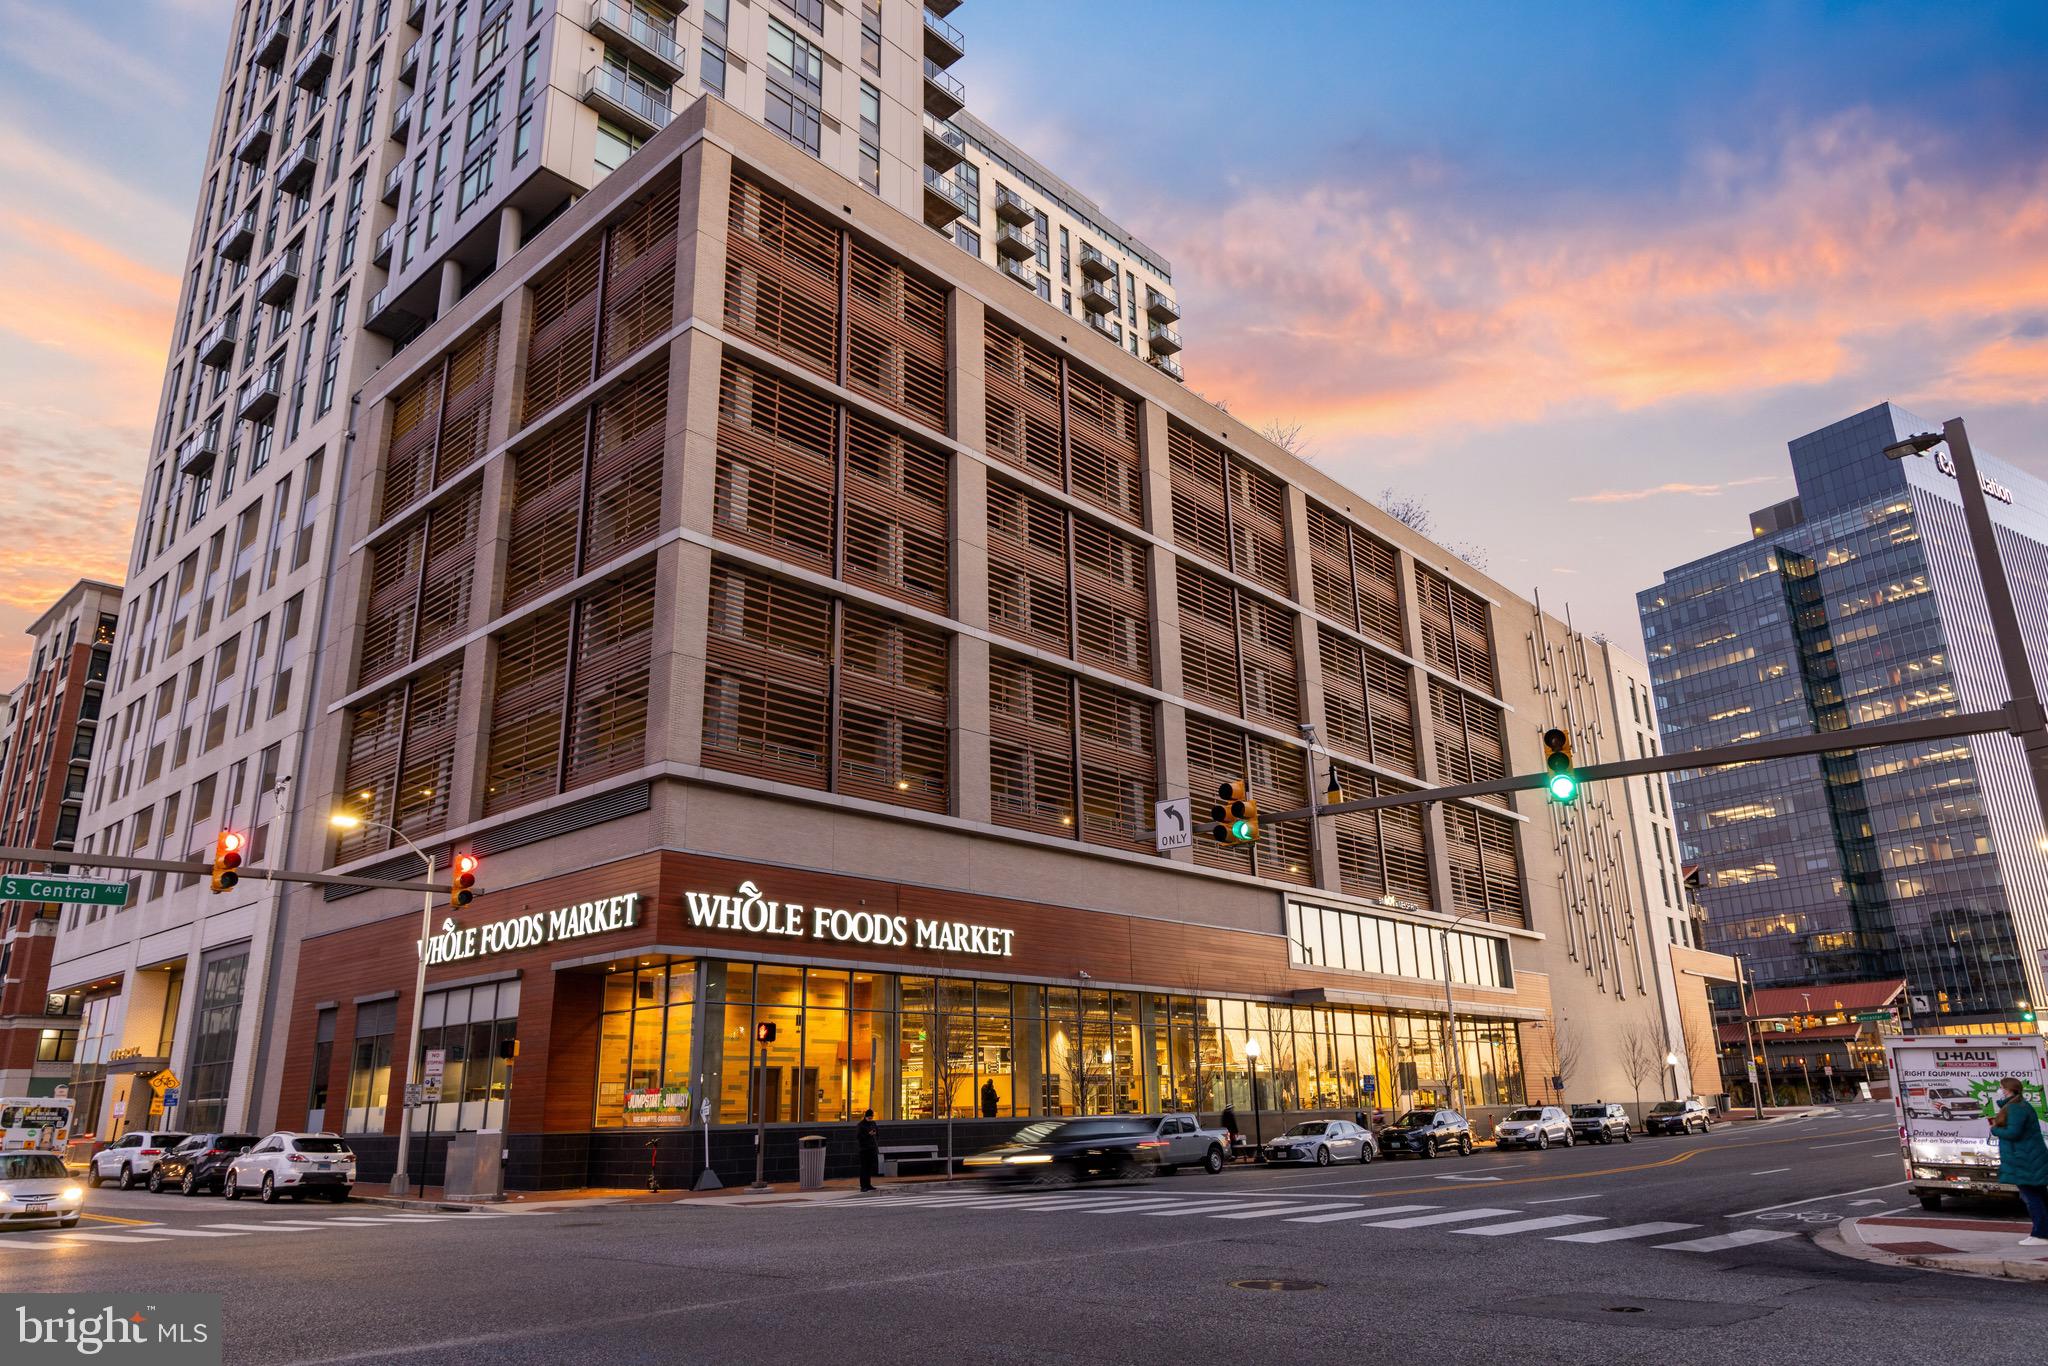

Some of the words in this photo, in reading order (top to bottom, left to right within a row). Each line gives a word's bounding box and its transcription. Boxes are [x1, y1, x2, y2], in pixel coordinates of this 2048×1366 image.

[1162, 833, 1187, 846] ONLY
[5, 881, 20, 895] S.
[30, 882, 97, 899] Central
[105, 886, 124, 894] AVE
[479, 915, 544, 955] FOODS
[548, 893, 638, 942] MARKET
[685, 881, 803, 937] WHOLE
[813, 907, 908, 947] FOODS
[915, 918, 1014, 956] MARKET
[2010, 1070, 2033, 1078] COST!
[1913, 1129, 1934, 1137] Drive
[1936, 1130, 1959, 1138] Now!
